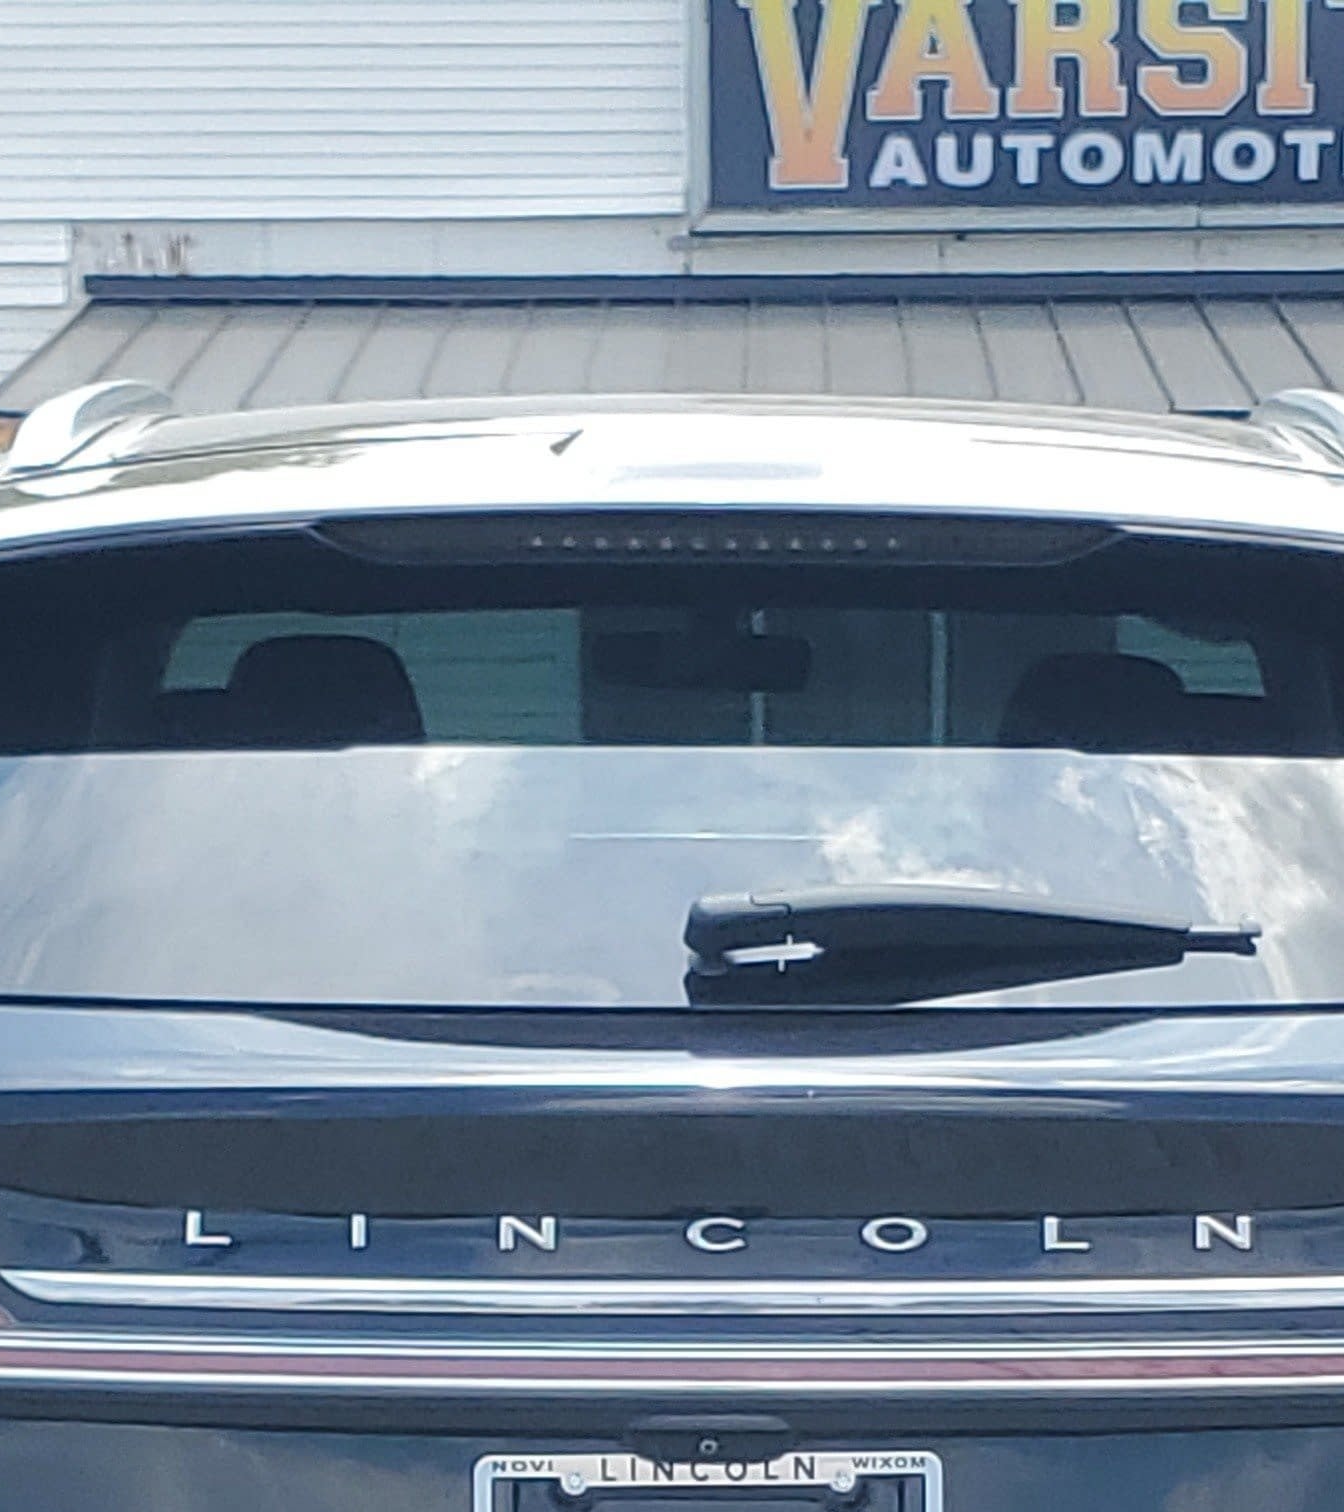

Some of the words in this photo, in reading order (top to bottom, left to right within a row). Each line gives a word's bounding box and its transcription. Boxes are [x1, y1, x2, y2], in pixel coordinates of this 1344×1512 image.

[183, 1208, 1254, 1253] LINCOLN
[491, 1459, 554, 1473] NOVI
[600, 1456, 816, 1482] LINCOLN
[851, 1455, 927, 1470] WIXOM
